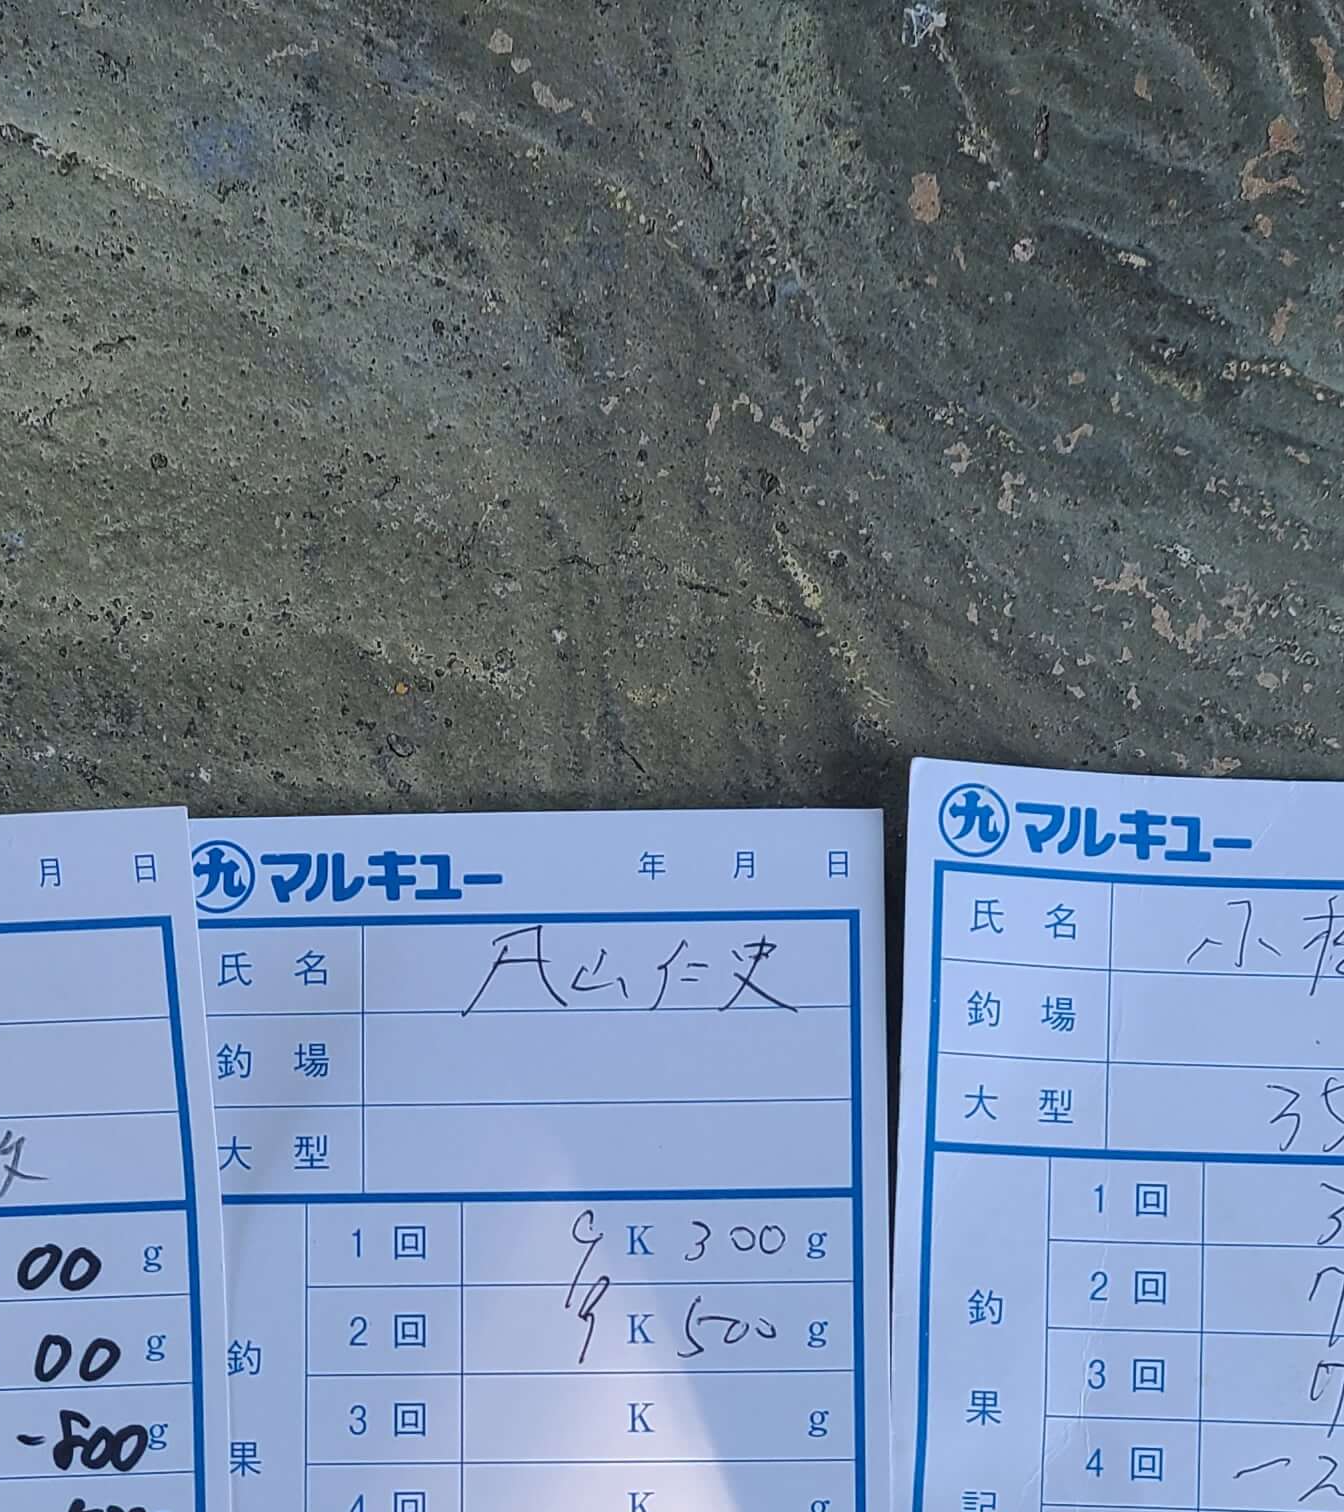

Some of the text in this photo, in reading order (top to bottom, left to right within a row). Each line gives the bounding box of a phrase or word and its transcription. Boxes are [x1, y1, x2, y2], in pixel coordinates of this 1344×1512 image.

[1014, 802, 1253, 863] マルキュー
[39, 857, 61, 888] 月
[134, 853, 157, 884] 日
[259, 850, 503, 904] マルキュー
[637, 850, 849, 881] 年 月 日
[969, 899, 1077, 941] 氏名
[217, 950, 328, 987] 氏名
[967, 990, 1076, 1032] 釣場
[214, 1040, 332, 1082] 釣場
[964, 1084, 1074, 1124] 大型
[218, 1133, 332, 1174] 大型
[1094, 1183, 1168, 1218] 1回
[351, 1225, 427, 1261] 1回
[16, 1243, 103, 1292] 00
[1089, 1270, 1167, 1305] 2回
[349, 1313, 427, 1349] 2回
[33, 1335, 122, 1384] 00
[1087, 1358, 1165, 1393] 3回
[349, 1402, 426, 1438] 3回
[1085, 1446, 1164, 1482] 4回
